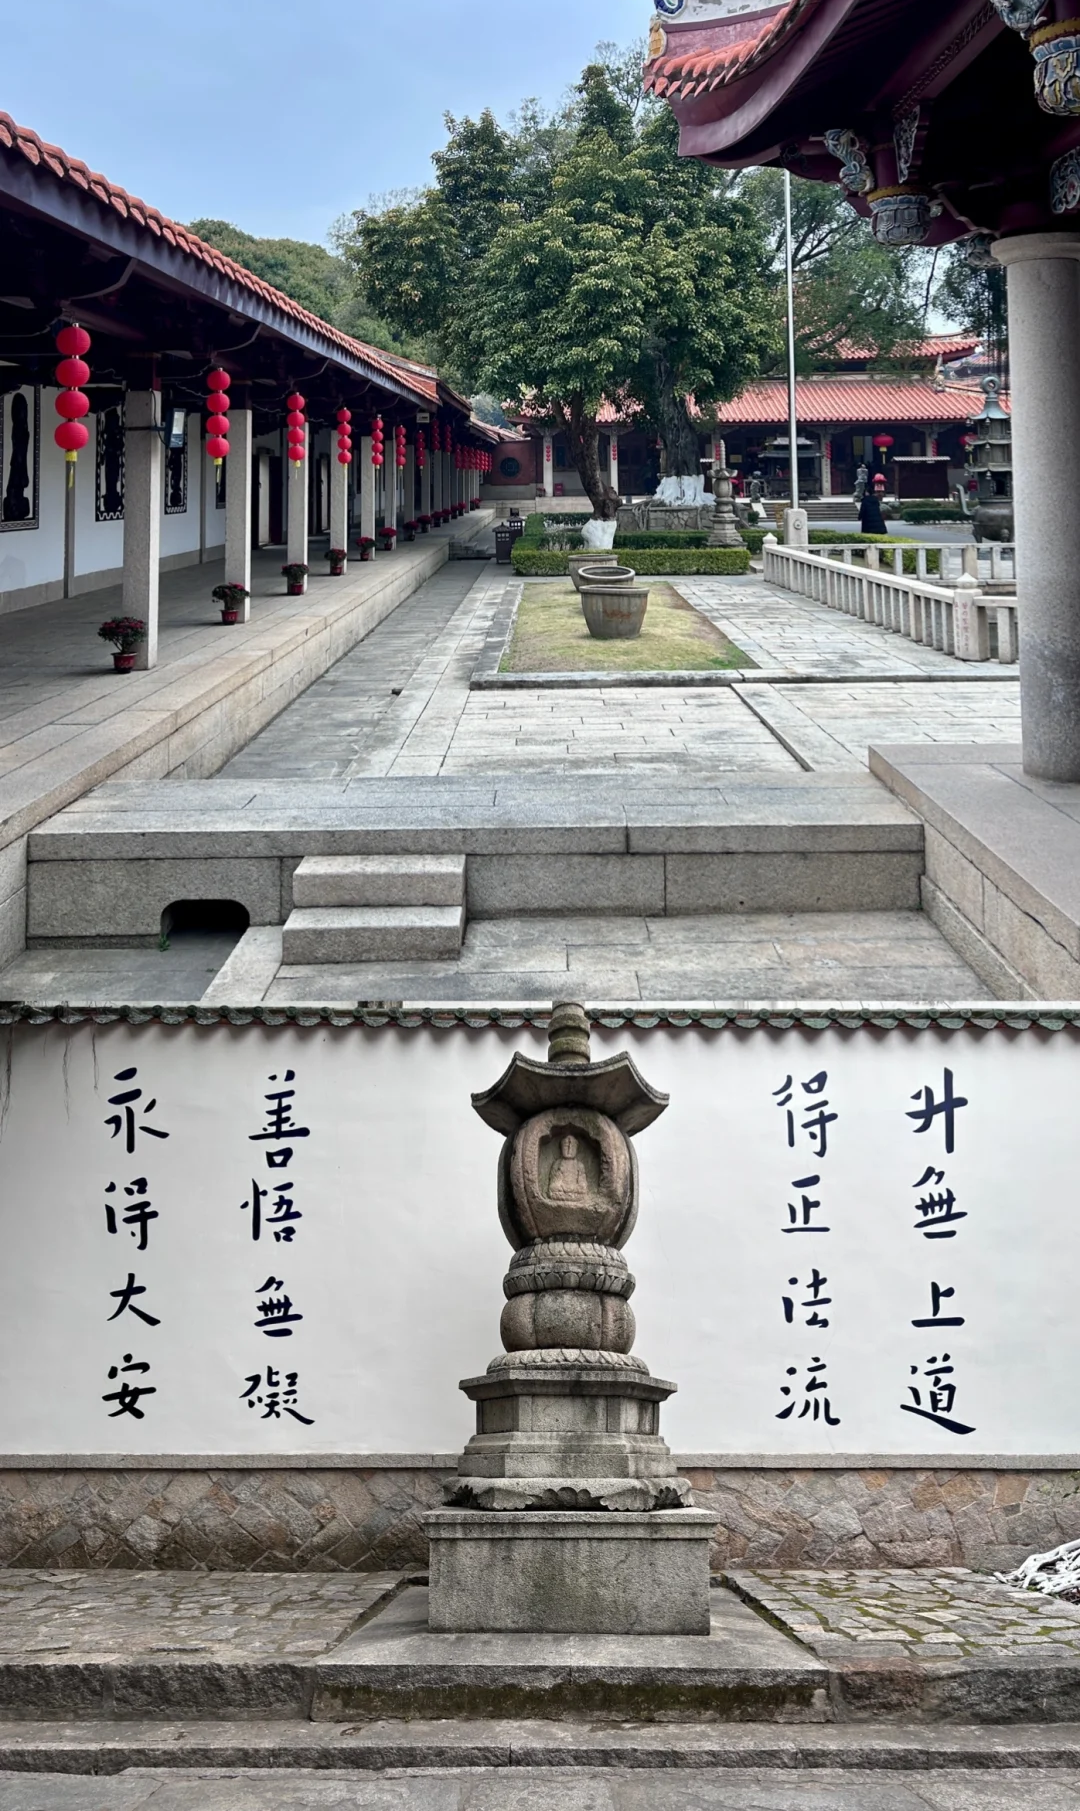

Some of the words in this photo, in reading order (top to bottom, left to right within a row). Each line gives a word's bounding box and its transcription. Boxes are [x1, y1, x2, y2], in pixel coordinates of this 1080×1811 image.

[102, 1067, 169, 1420] 永得大安
[772, 1070, 841, 1426] 得正法流
